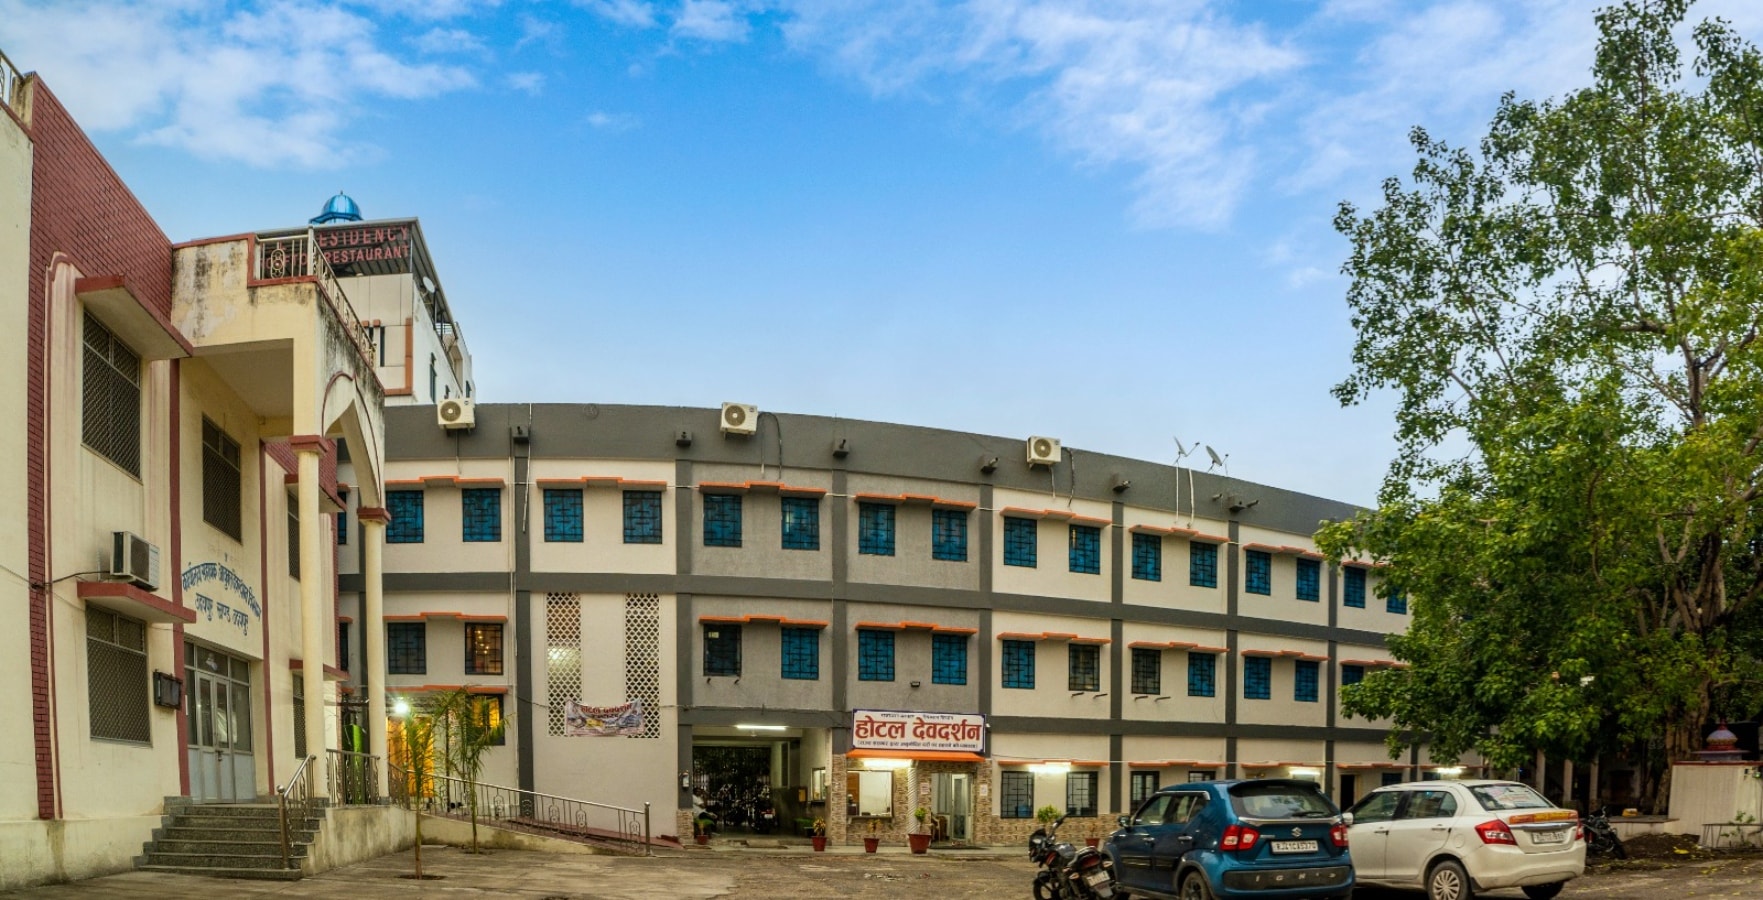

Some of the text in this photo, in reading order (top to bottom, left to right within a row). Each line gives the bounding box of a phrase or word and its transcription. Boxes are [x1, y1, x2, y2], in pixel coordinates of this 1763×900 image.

[318, 226, 409, 248] ESIDENCY
[325, 245, 410, 264] RESTAURANT
[855, 715, 982, 741] होटल देवदर्शन
